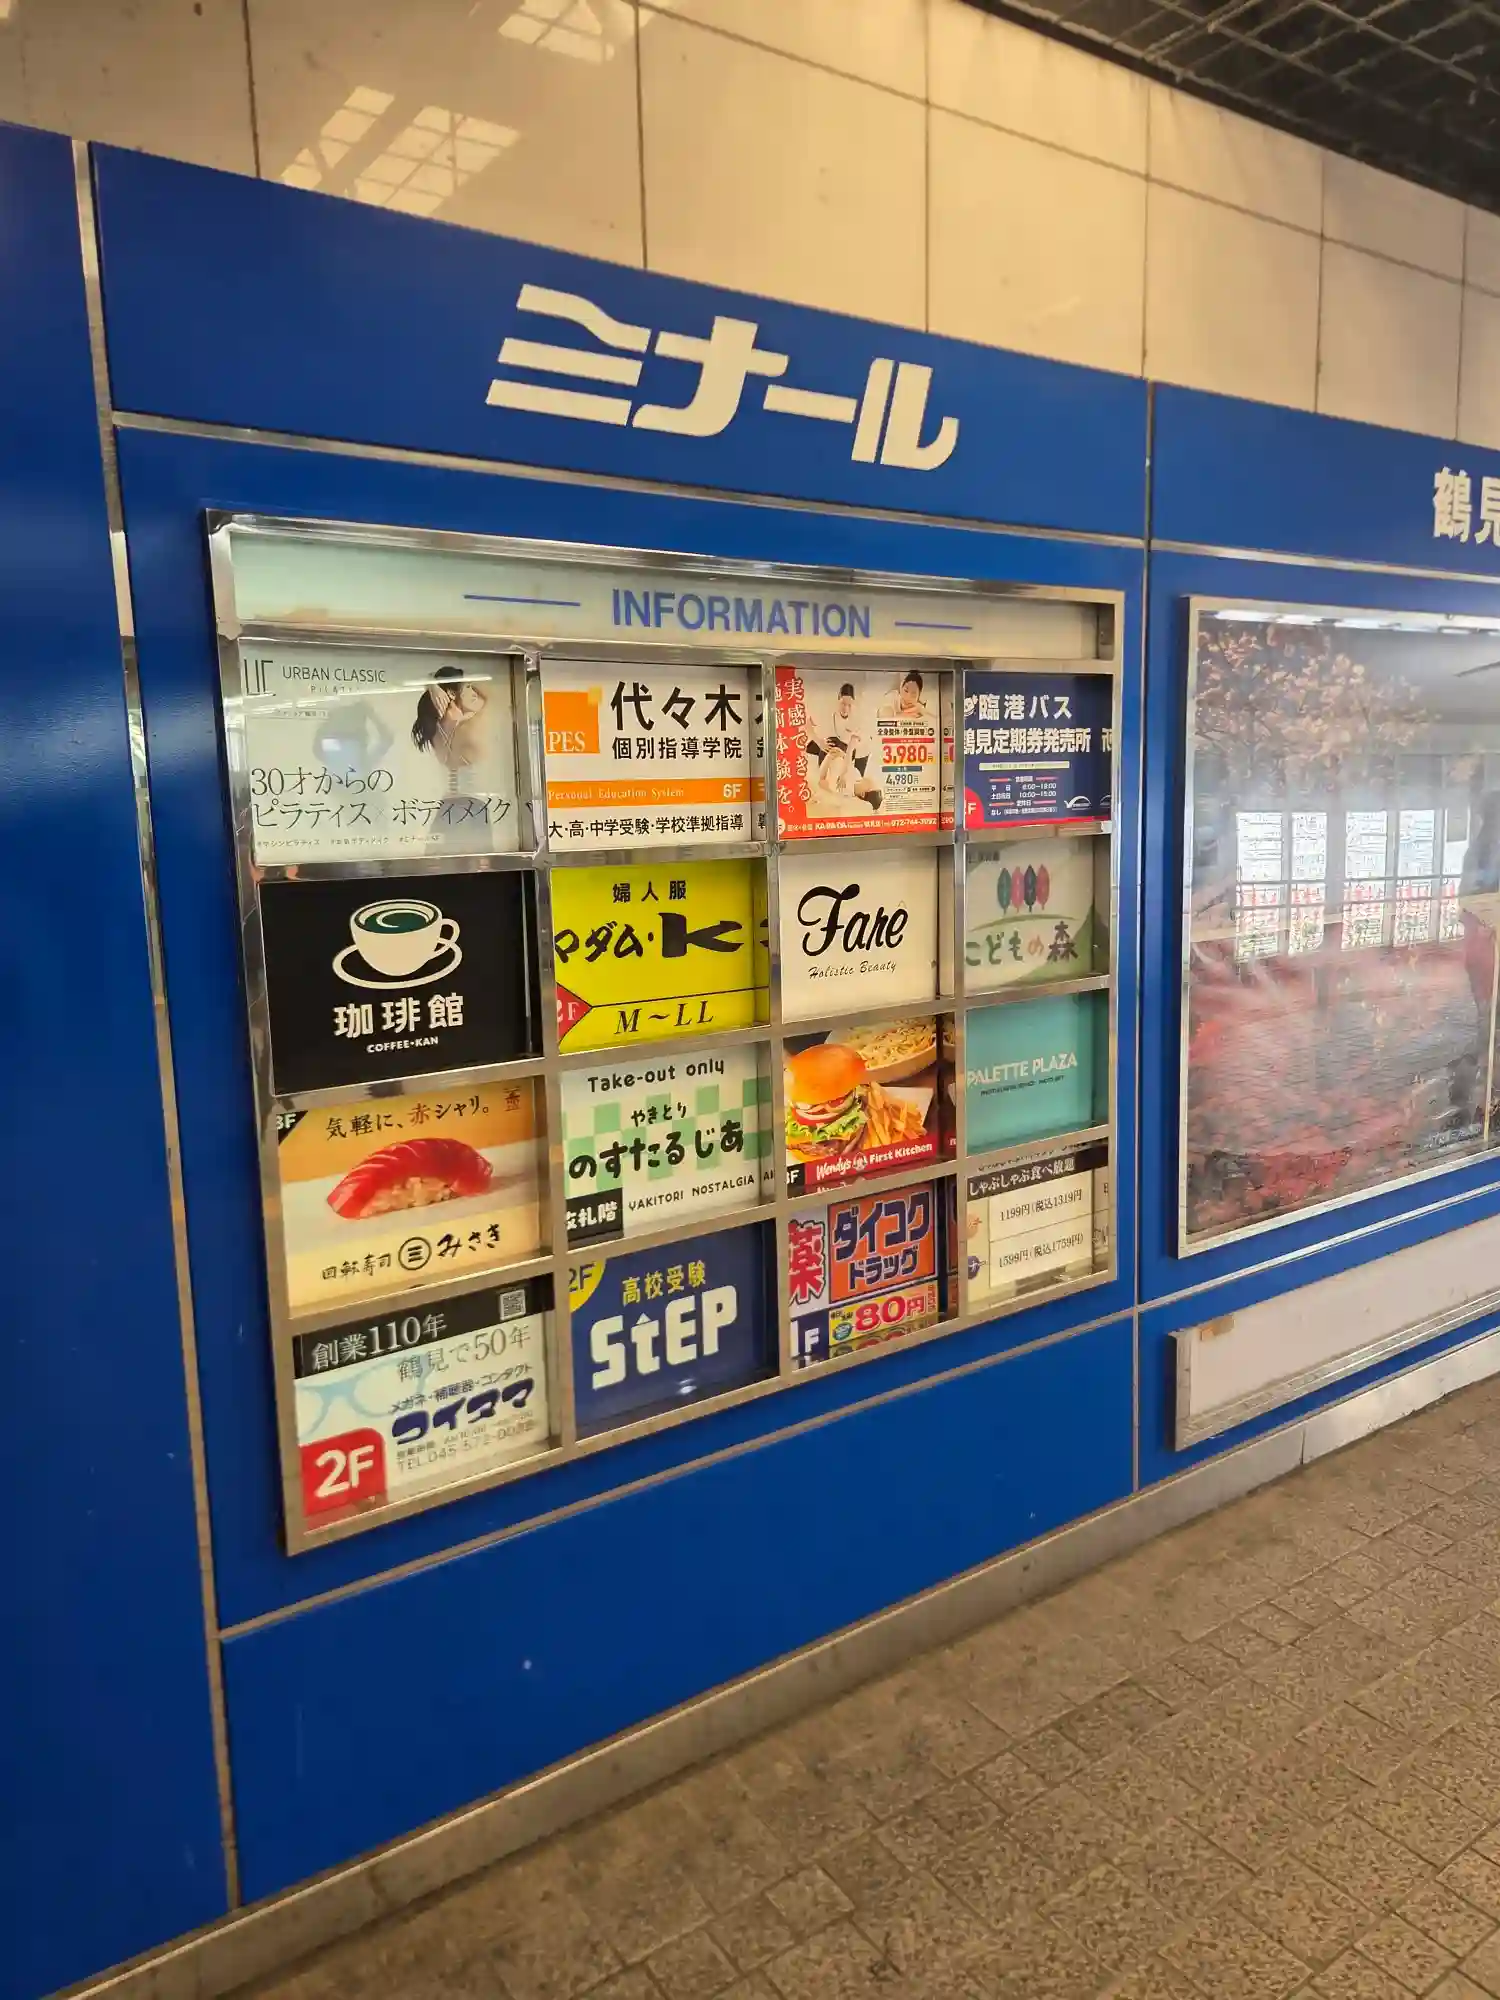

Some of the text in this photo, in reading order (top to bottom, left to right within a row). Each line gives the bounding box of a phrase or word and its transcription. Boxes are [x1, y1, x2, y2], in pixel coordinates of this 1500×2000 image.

[485, 283, 959, 471] ミナール
[1432, 465, 1500, 548] 鶴見
[611, 588, 871, 638] INFORMATION
[282, 666, 386, 683] URBAN CLASSIC
[610, 681, 743, 732] 代々木
[979, 693, 1073, 721] 臨港バス
[547, 731, 586, 753] PES
[612, 737, 743, 760] 個別指導学院
[784, 677, 812, 802] 実感できる
[251, 766, 394, 796] 30才からの
[548, 786, 684, 801] Personal Education System
[723, 783, 743, 798] 6F
[612, 880, 687, 904] 婦人服
[965, 920, 1079, 967] こどもの森
[808, 960, 897, 980] Holistic Beauty
[332, 992, 464, 1039] 珈琲館
[588, 1058, 725, 1093] Take-out only
[967, 1060, 1029, 1088] PALETTE
[1032, 1052, 1078, 1076] PLAZA
[325, 1095, 490, 1142] 気軽に、赤シャリ。
[631, 1102, 687, 1127] やきとり
[568, 1119, 744, 1179] のすたるじあ
[816, 1142, 933, 1180] Wendy's First Kitchen
[628, 1174, 755, 1212] YAKITORI NOSTALGIA
[969, 1156, 1076, 1196] しゃぶしゃぶ食べ放題
[437, 1223, 501, 1259] みさき
[831, 1190, 932, 1262] ダイコク
[569, 1261, 595, 1293] 2F
[622, 1260, 706, 1307] 高校受験
[849, 1245, 920, 1292] ドラッグ
[855, 1294, 926, 1332] 80円
[312, 1312, 448, 1372] 創業110年
[398, 1324, 531, 1383] 鶴見で50年
[314, 1445, 375, 1498] 2F
